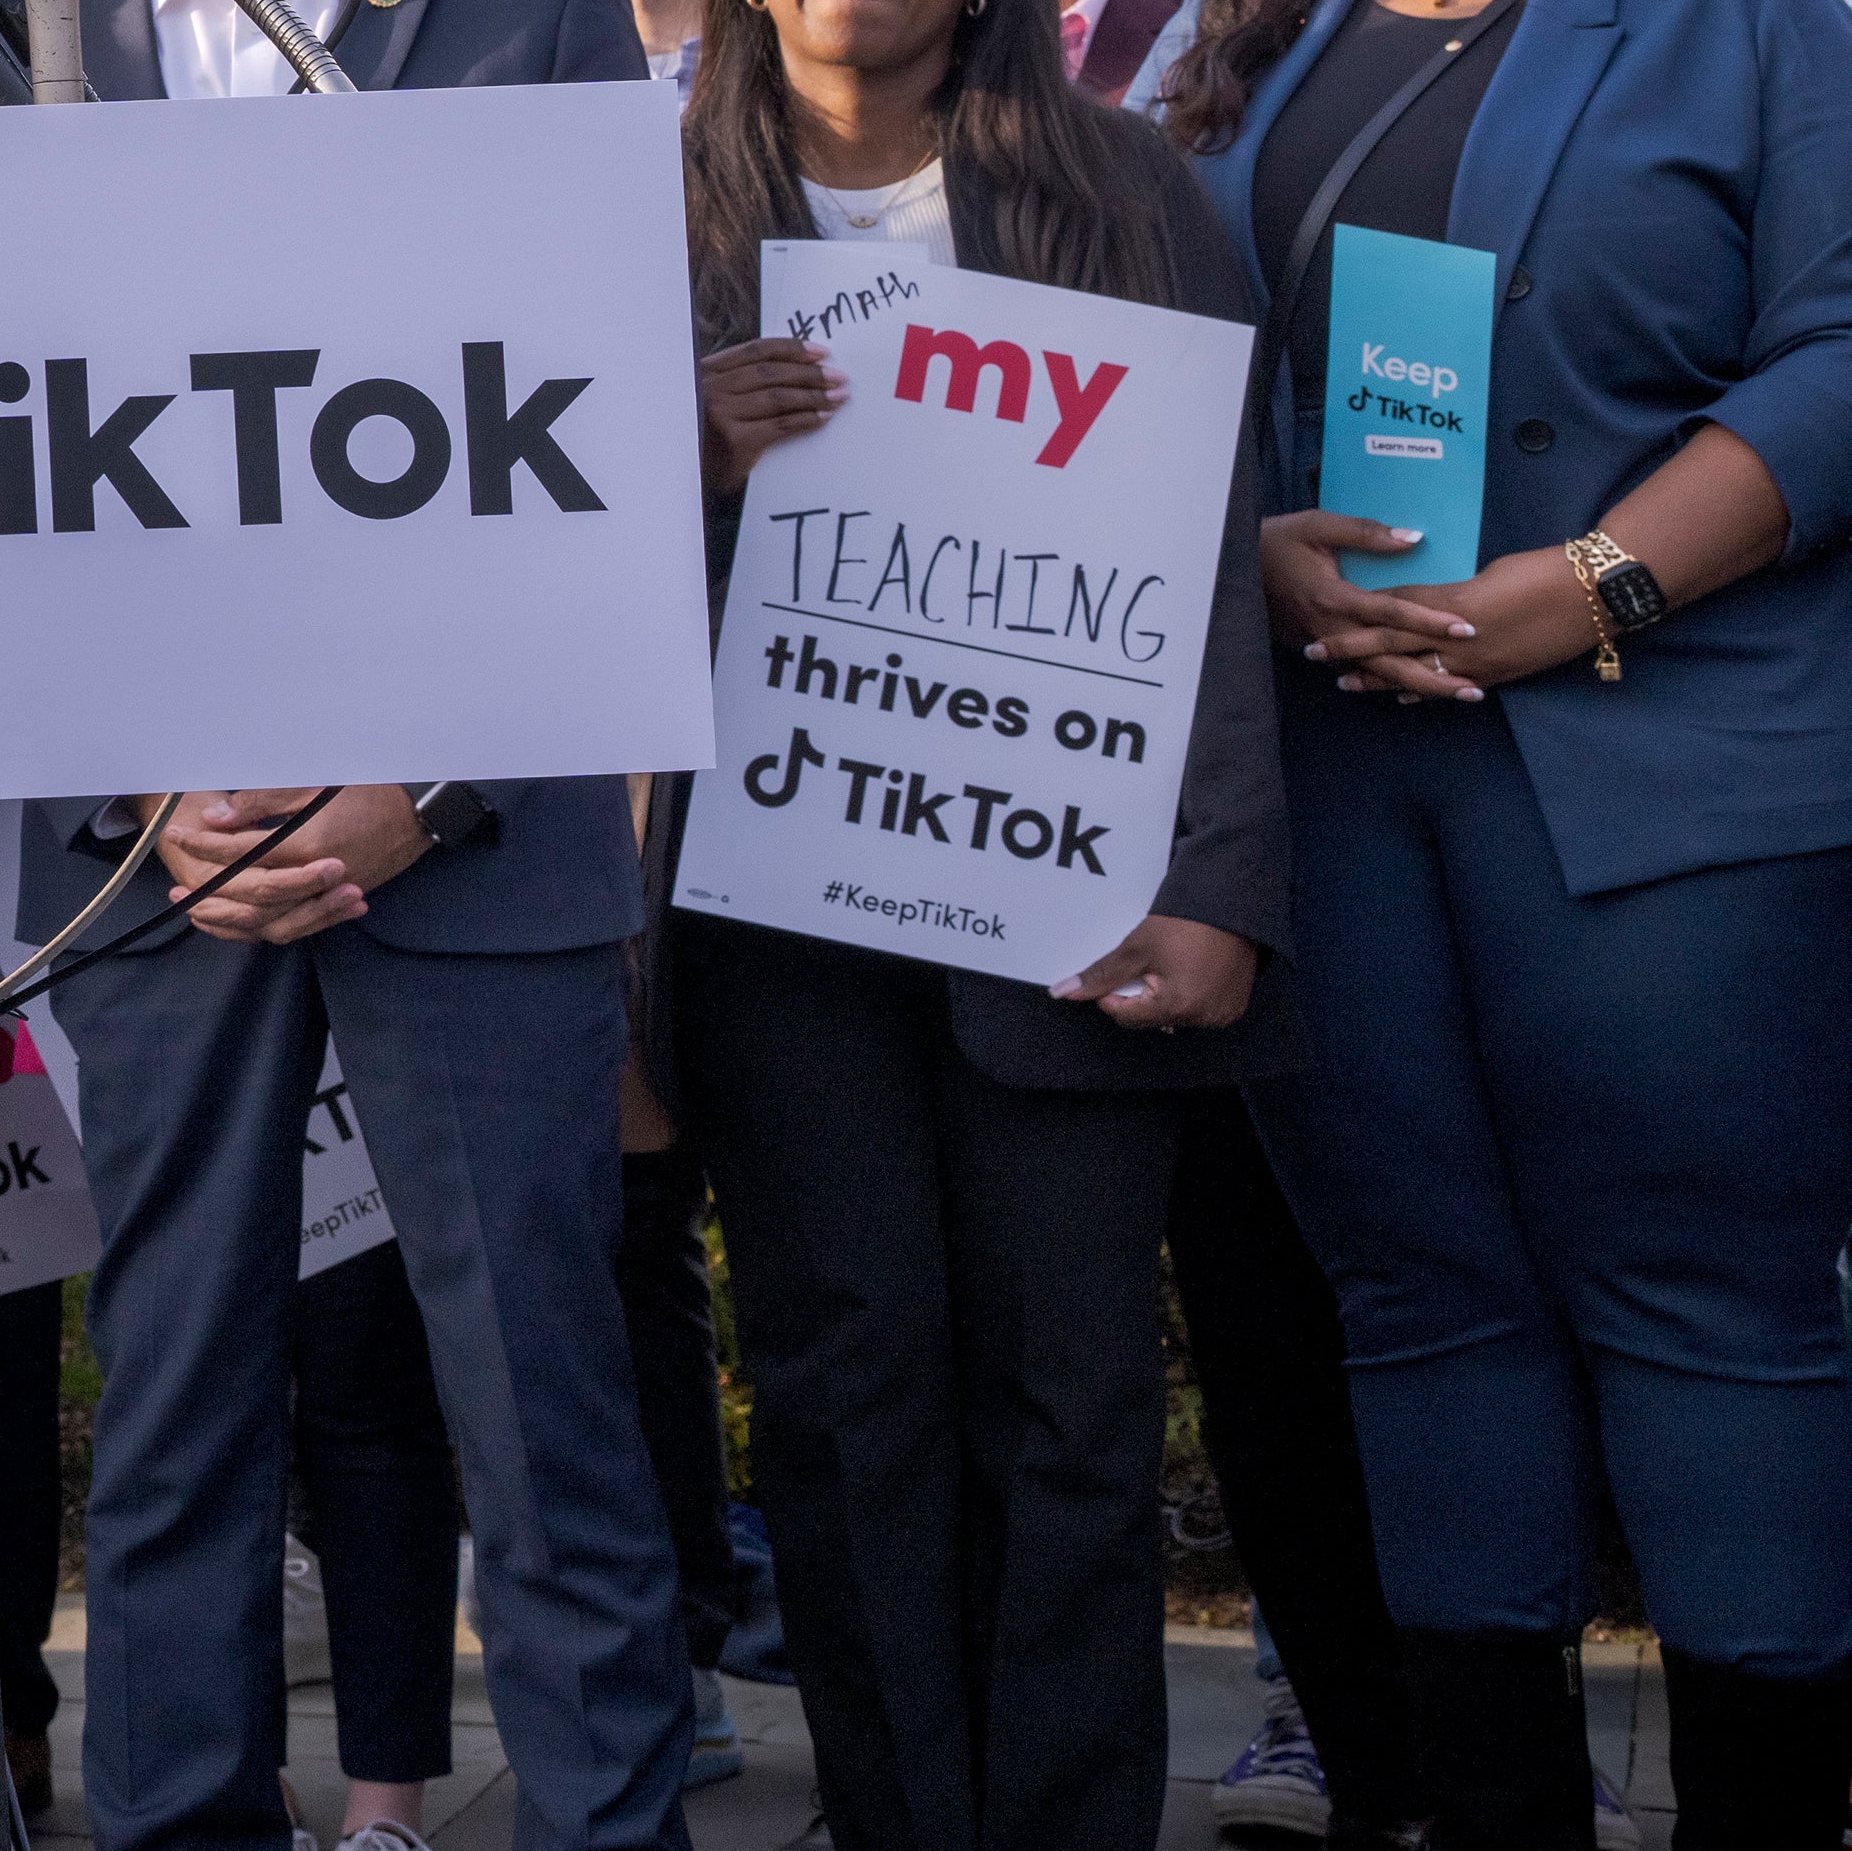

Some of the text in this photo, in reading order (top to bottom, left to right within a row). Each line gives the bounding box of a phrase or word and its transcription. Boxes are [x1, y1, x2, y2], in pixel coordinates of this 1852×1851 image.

[894, 323, 1130, 469] my
[1361, 341, 1459, 399] Keep
[1376, 395, 1464, 434] TikTok
[1371, 440, 1437, 454] Learn more
[769, 508, 1167, 663] TEACHING
[765, 633, 1147, 764] thrives on
[838, 757, 1113, 877] TikTok
[821, 880, 1007, 941] #KeepTikTok
